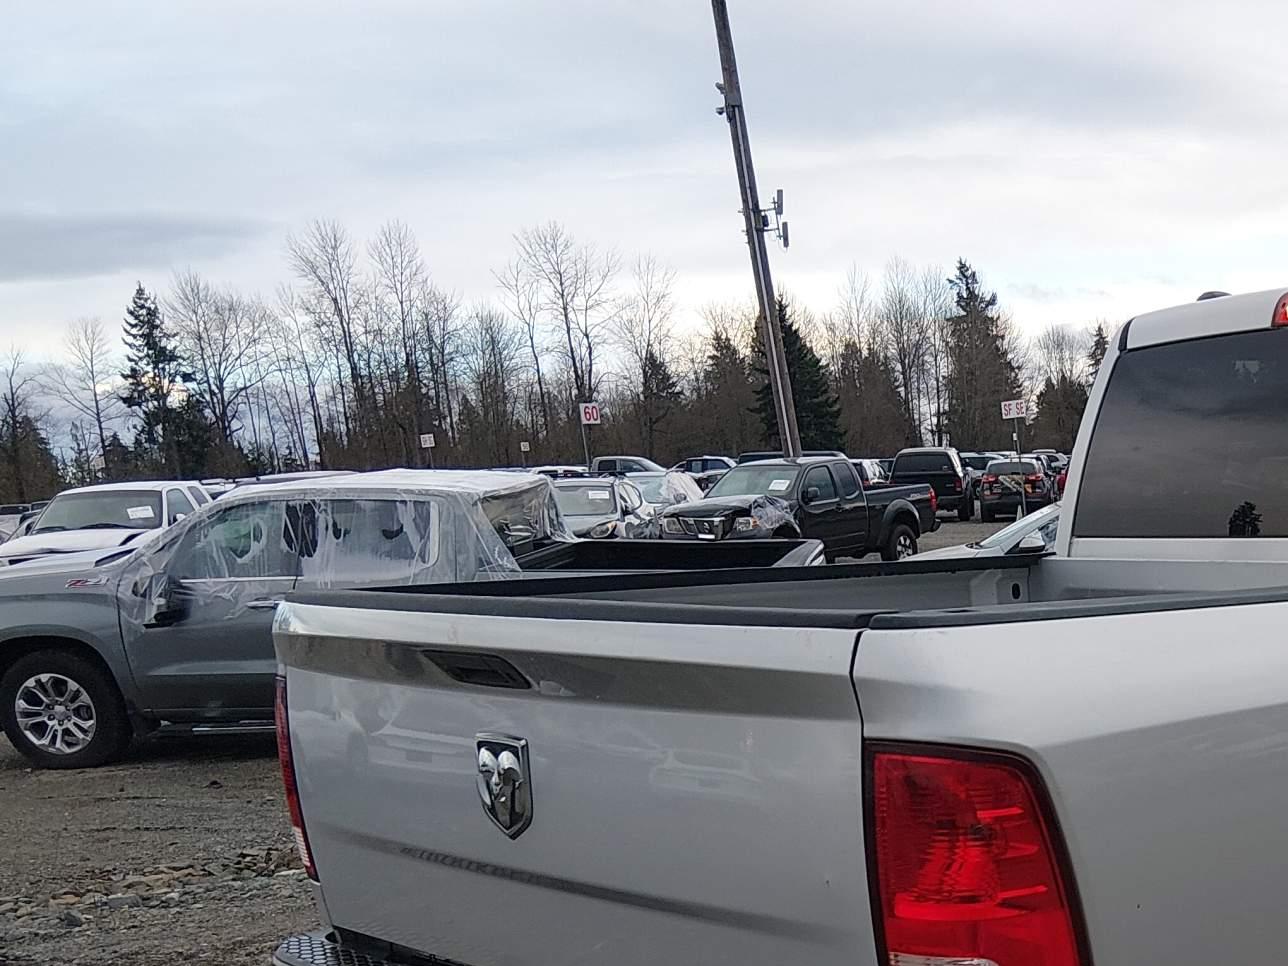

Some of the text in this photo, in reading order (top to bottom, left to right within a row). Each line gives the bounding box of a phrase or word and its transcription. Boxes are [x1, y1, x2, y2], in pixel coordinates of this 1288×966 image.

[584, 405, 599, 421] 60
[1003, 402, 1025, 417] SF SE
